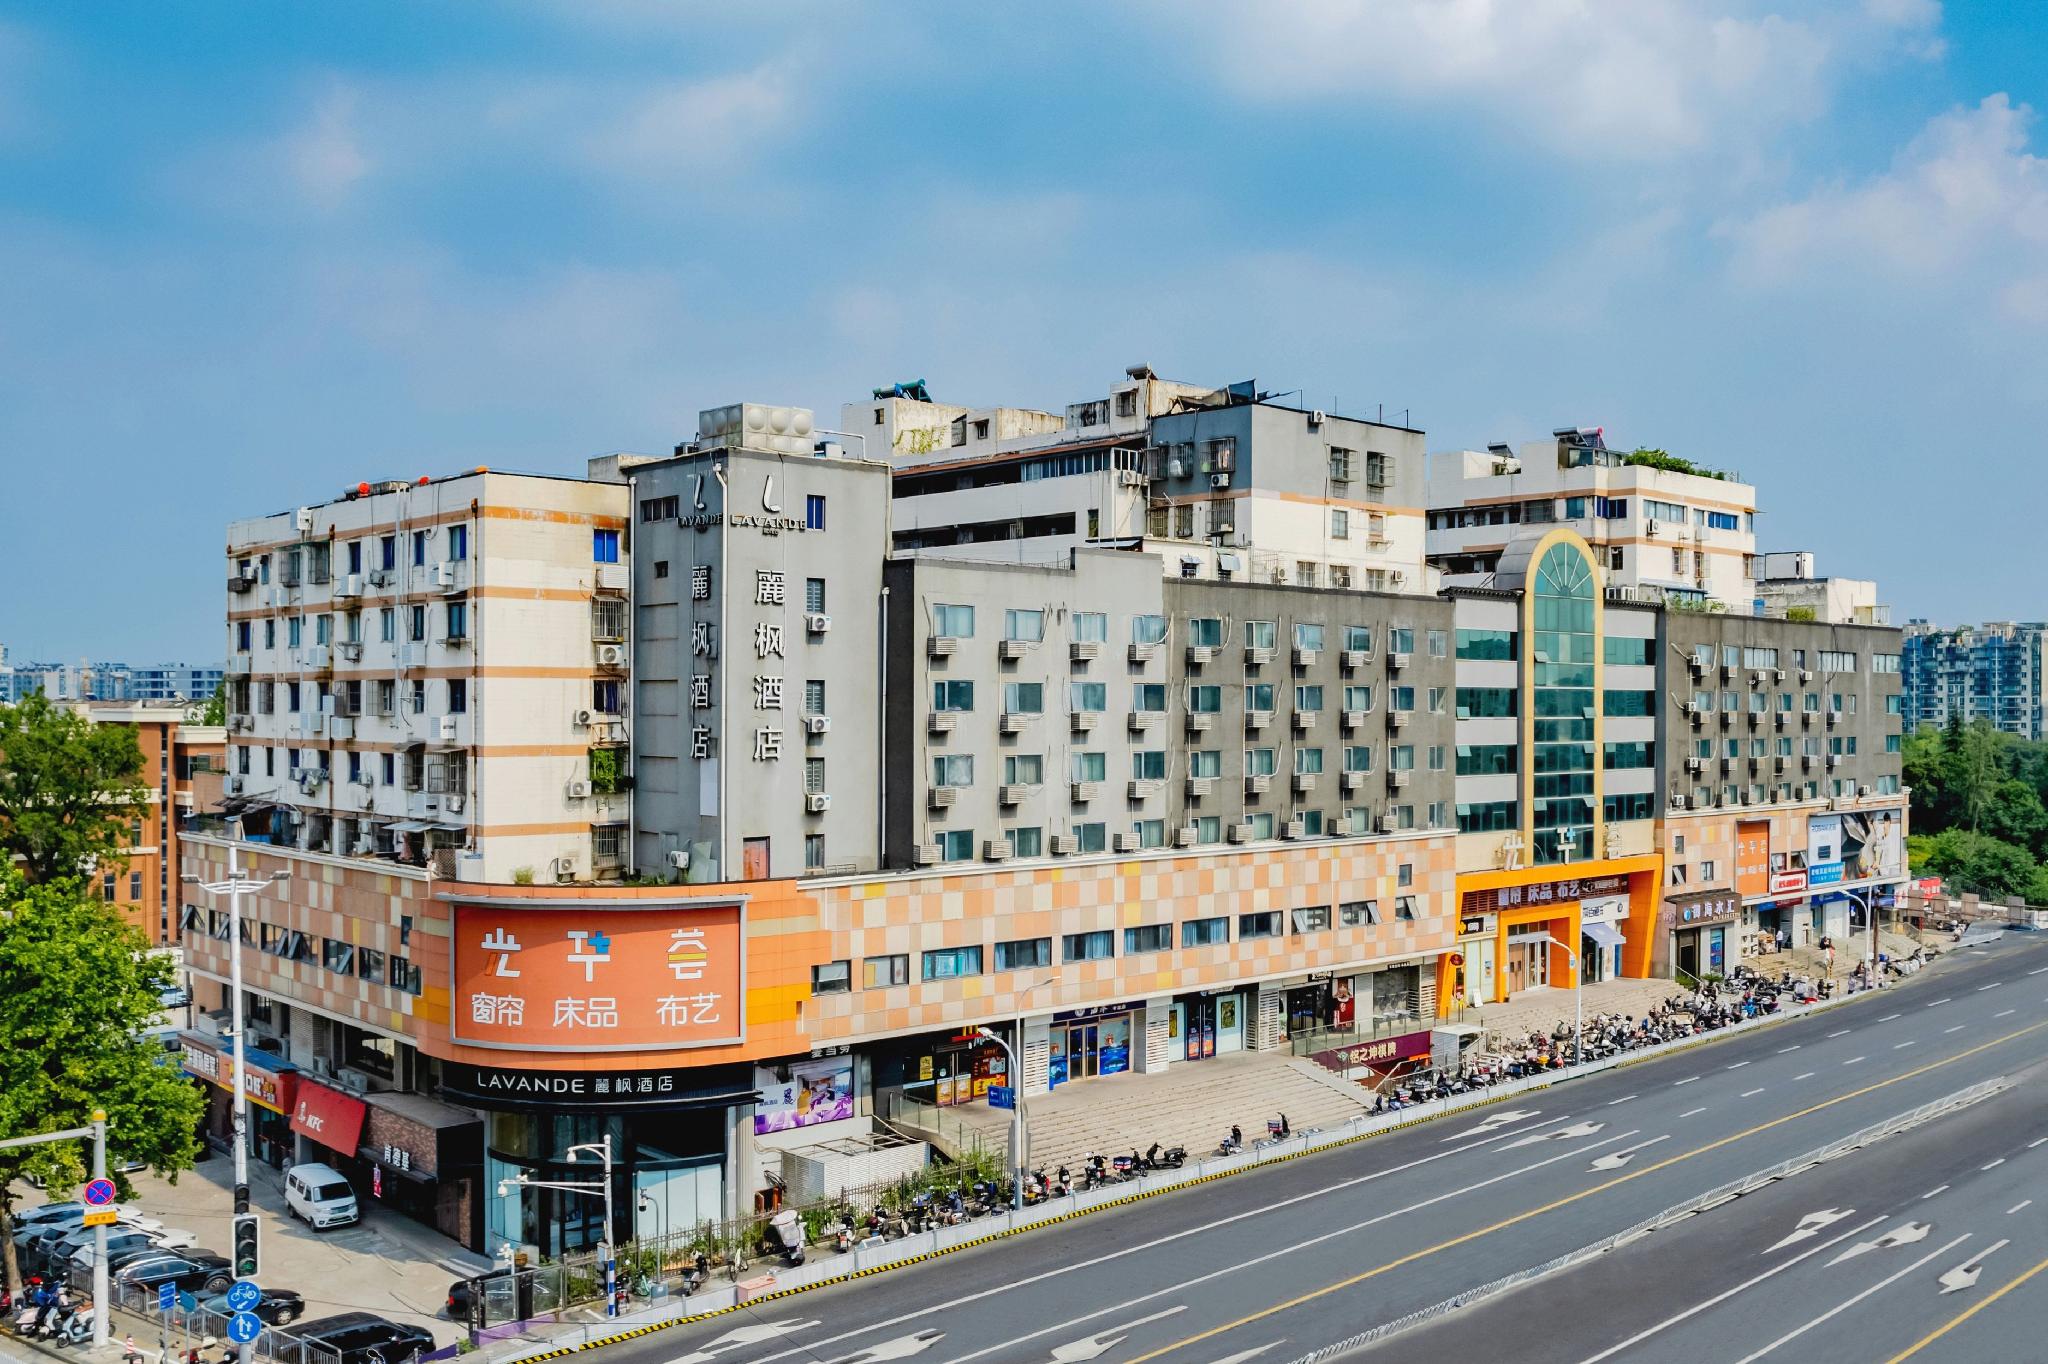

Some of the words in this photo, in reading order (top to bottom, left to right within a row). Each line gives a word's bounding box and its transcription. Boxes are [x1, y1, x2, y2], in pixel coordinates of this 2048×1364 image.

[730, 514, 806, 531] LAVANDE
[691, 565, 711, 759] 麗枫酒店
[753, 569, 785, 761] 麗枫酒店
[471, 991, 525, 1027] 窗帘
[552, 996, 618, 1029] 床品
[656, 992, 722, 1026] 布艺
[477, 1071, 585, 1094] LAVANDE
[594, 1075, 673, 1094] 麗枫酒店
[306, 1115, 324, 1132] KFC
